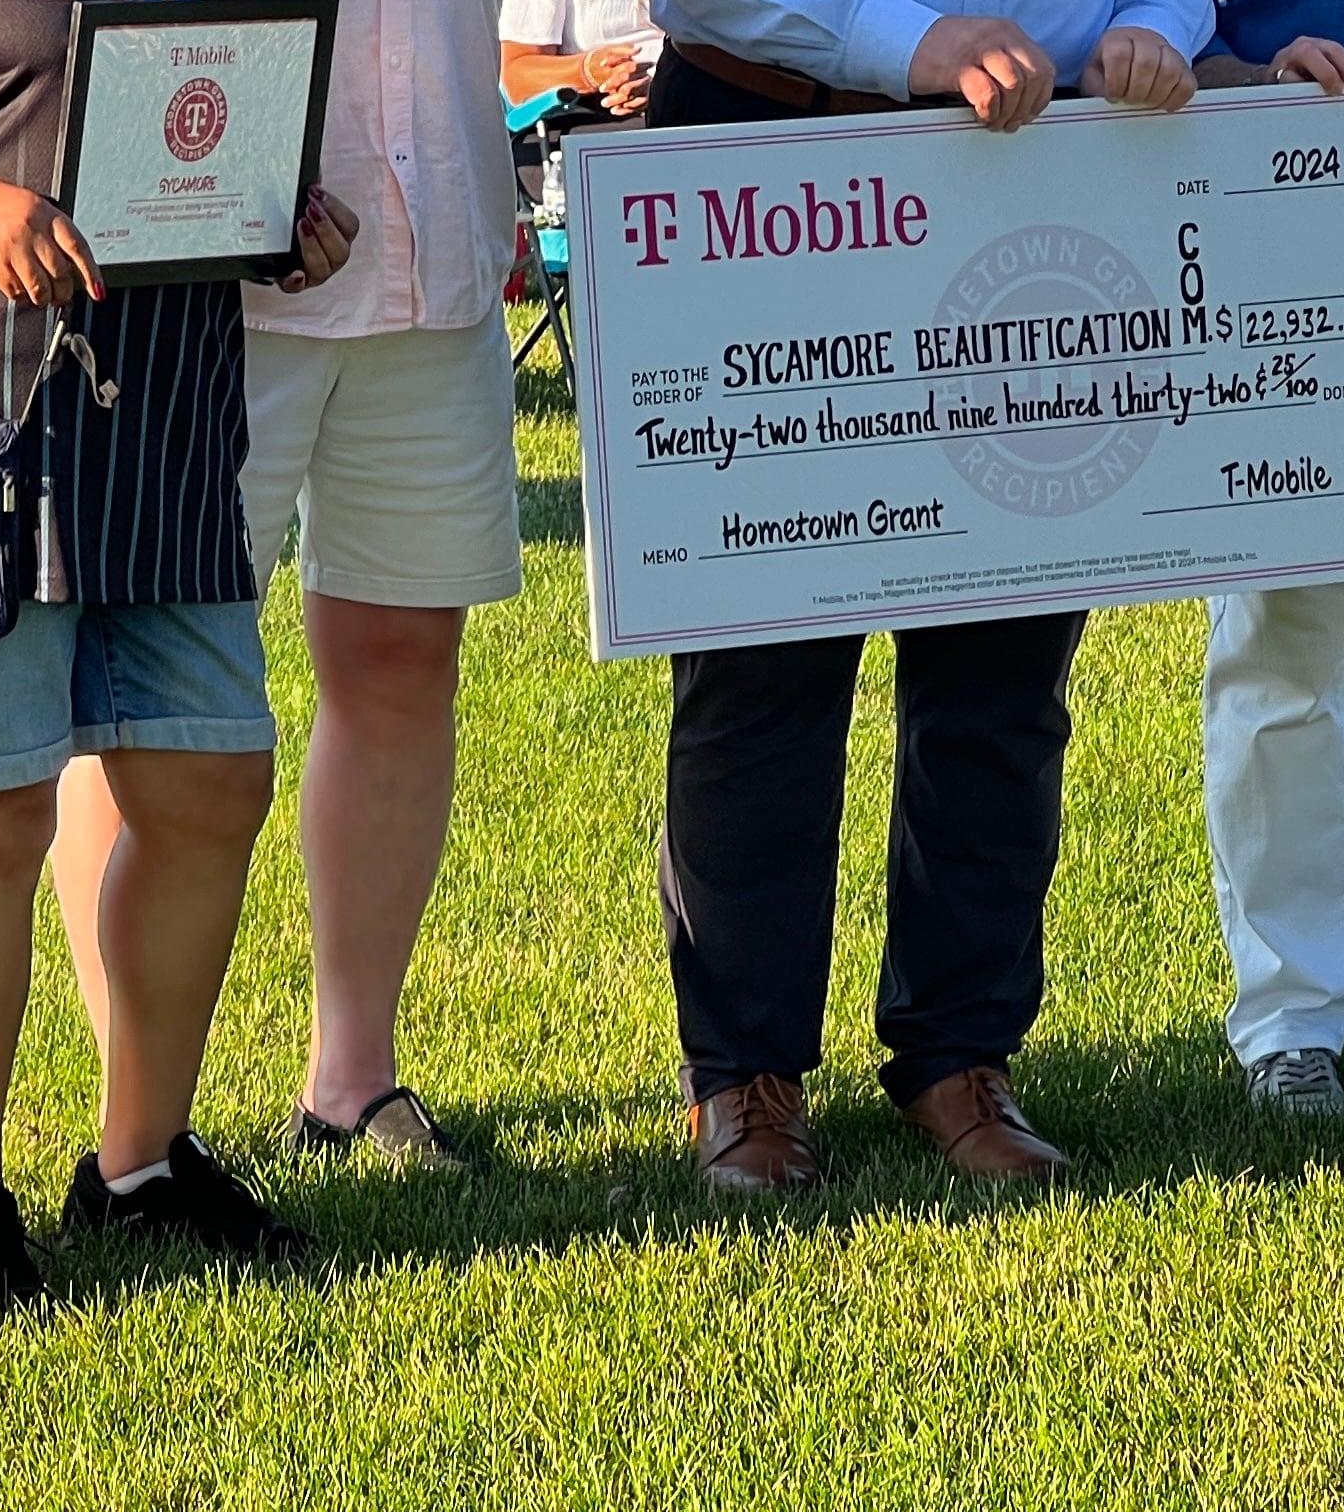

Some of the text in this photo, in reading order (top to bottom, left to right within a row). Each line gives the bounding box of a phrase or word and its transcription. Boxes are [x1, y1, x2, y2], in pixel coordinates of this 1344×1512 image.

[186, 45, 236, 66] Mobile
[1272, 146, 1341, 184] 2024
[159, 175, 218, 195] SYCAMORE
[1177, 179, 1210, 196] DATE
[623, 176, 928, 266] T Mobile
[722, 308, 1171, 389] SYCAMORE BEAUTIFICATION
[632, 366, 709, 388] PAY TO THE
[632, 387, 703, 406] ORDER OF
[635, 413, 808, 471] Twenty-two
[815, 390, 941, 443] thousand
[948, 396, 998, 431] nine
[1003, 381, 1103, 425] hundred
[1111, 371, 1252, 426] thirty-two
[1220, 455, 1333, 500] T-Mobile
[721, 497, 944, 550] Hometown Grant
[643, 547, 688, 565] MEMO
